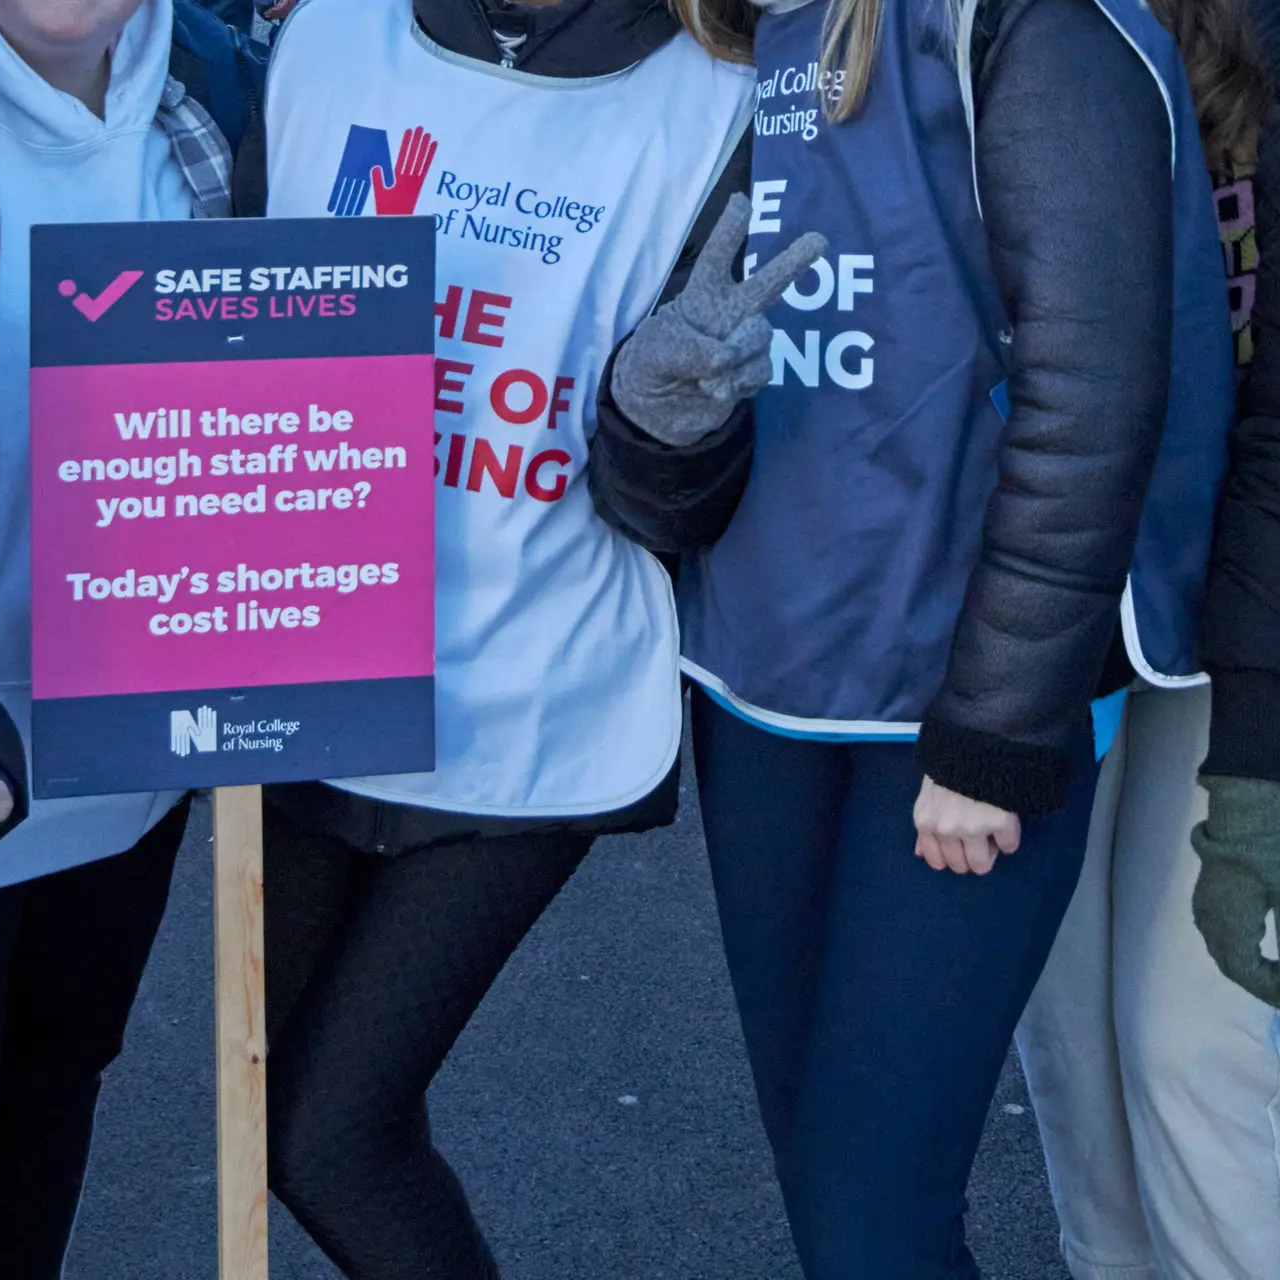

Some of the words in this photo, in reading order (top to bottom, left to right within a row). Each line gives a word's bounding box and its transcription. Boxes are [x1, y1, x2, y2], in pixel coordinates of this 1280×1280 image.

[437, 170, 511, 212] Royal
[516, 189, 605, 233] College
[460, 213, 563, 264] Nursing
[155, 269, 242, 293] SAFE
[249, 265, 408, 291] STAFFING
[781, 255, 874, 311] OF
[157, 296, 258, 320] SAVES
[270, 294, 356, 317] LIVES
[434, 285, 512, 348] HE
[769, 328, 874, 389] NG
[490, 369, 575, 429] OF
[114, 408, 190, 440] Will
[200, 408, 300, 436] there
[309, 404, 353, 432] be
[59, 449, 201, 485] enough
[210, 444, 297, 475] staff
[304, 442, 406, 471] when
[96, 496, 165, 527] you
[175, 485, 266, 516] need
[275, 481, 371, 511] care?
[66, 567, 209, 603] Today’s
[217, 563, 399, 593] shortages
[149, 607, 228, 635] cost
[237, 600, 320, 630] lives
[223, 720, 255, 738] Royal
[257, 719, 300, 735] College
[223, 738, 235, 750] of
[237, 733, 284, 751] Nursing
